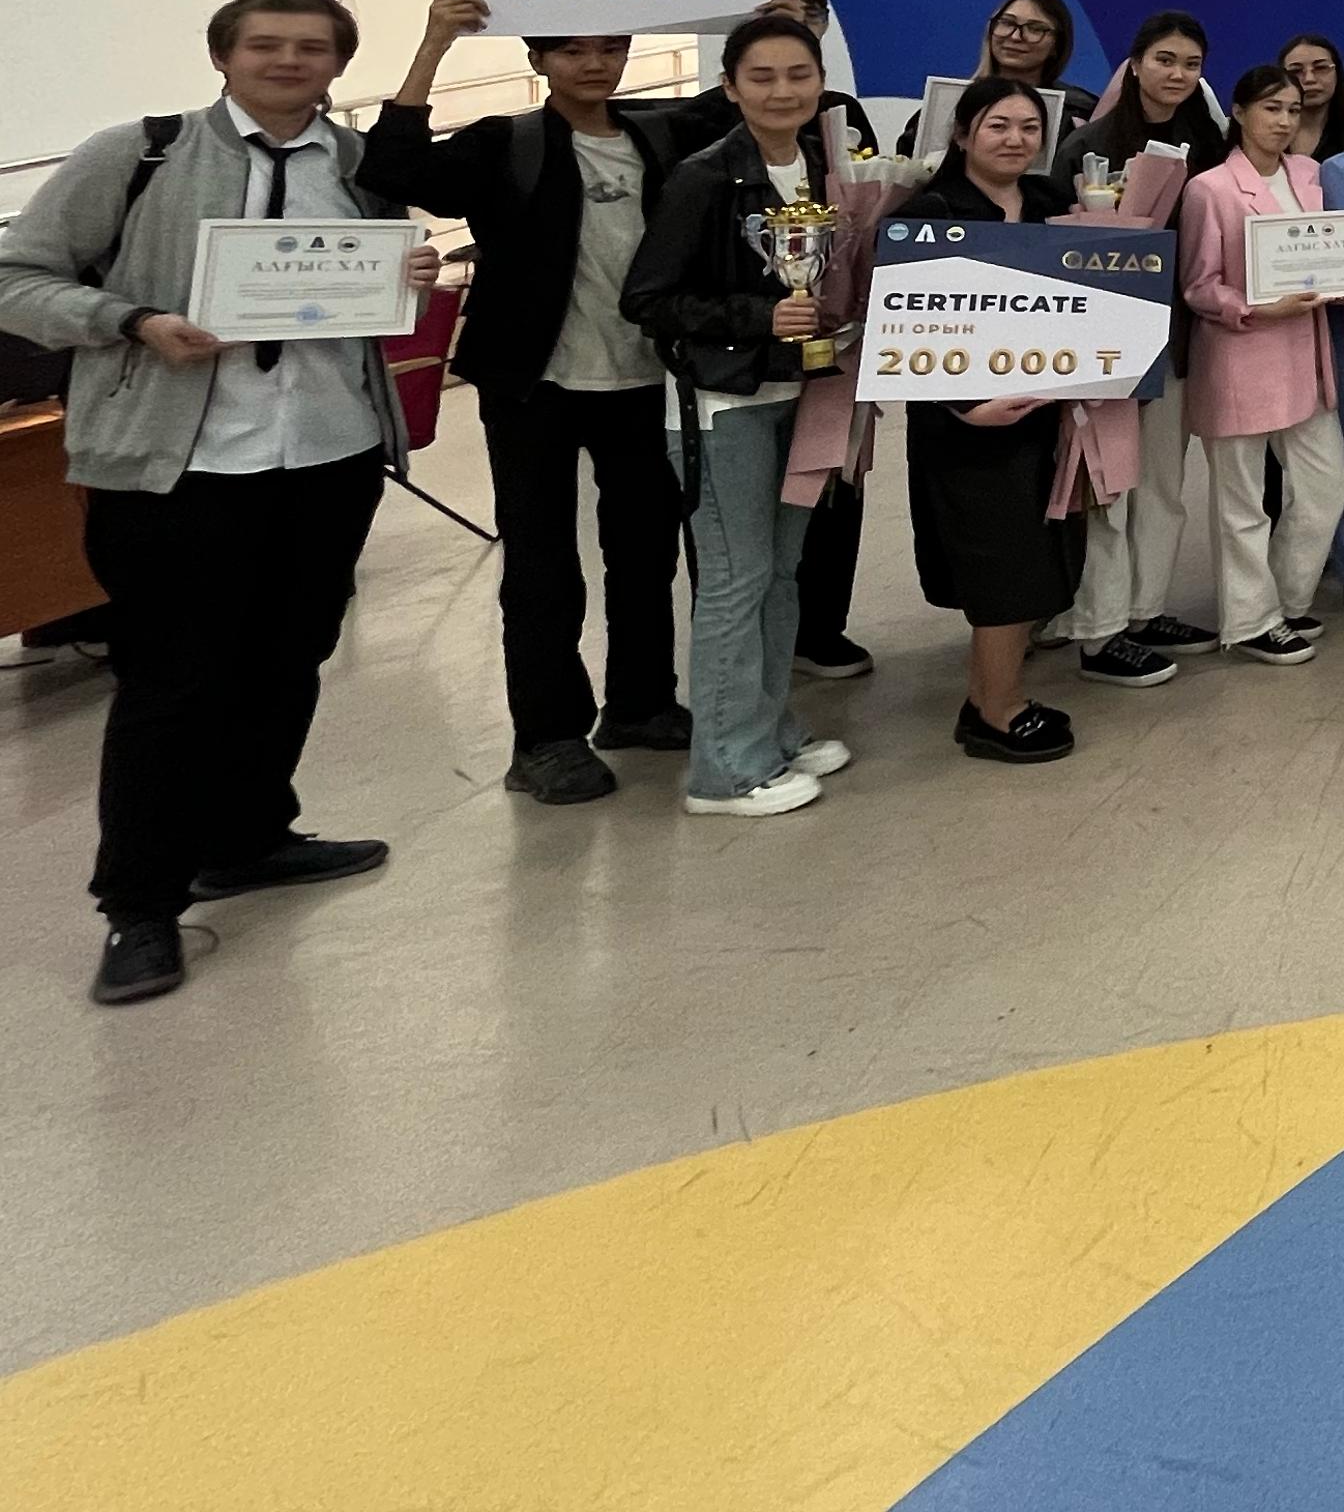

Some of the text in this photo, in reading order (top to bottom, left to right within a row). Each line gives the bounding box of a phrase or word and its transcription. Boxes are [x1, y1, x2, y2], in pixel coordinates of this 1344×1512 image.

[337, 260, 382, 272] ХАТ
[883, 292, 1088, 313] CERTIFICATE
[912, 323, 976, 335] ОРЫН
[876, 348, 971, 375] 200
[988, 348, 1078, 376] 000
